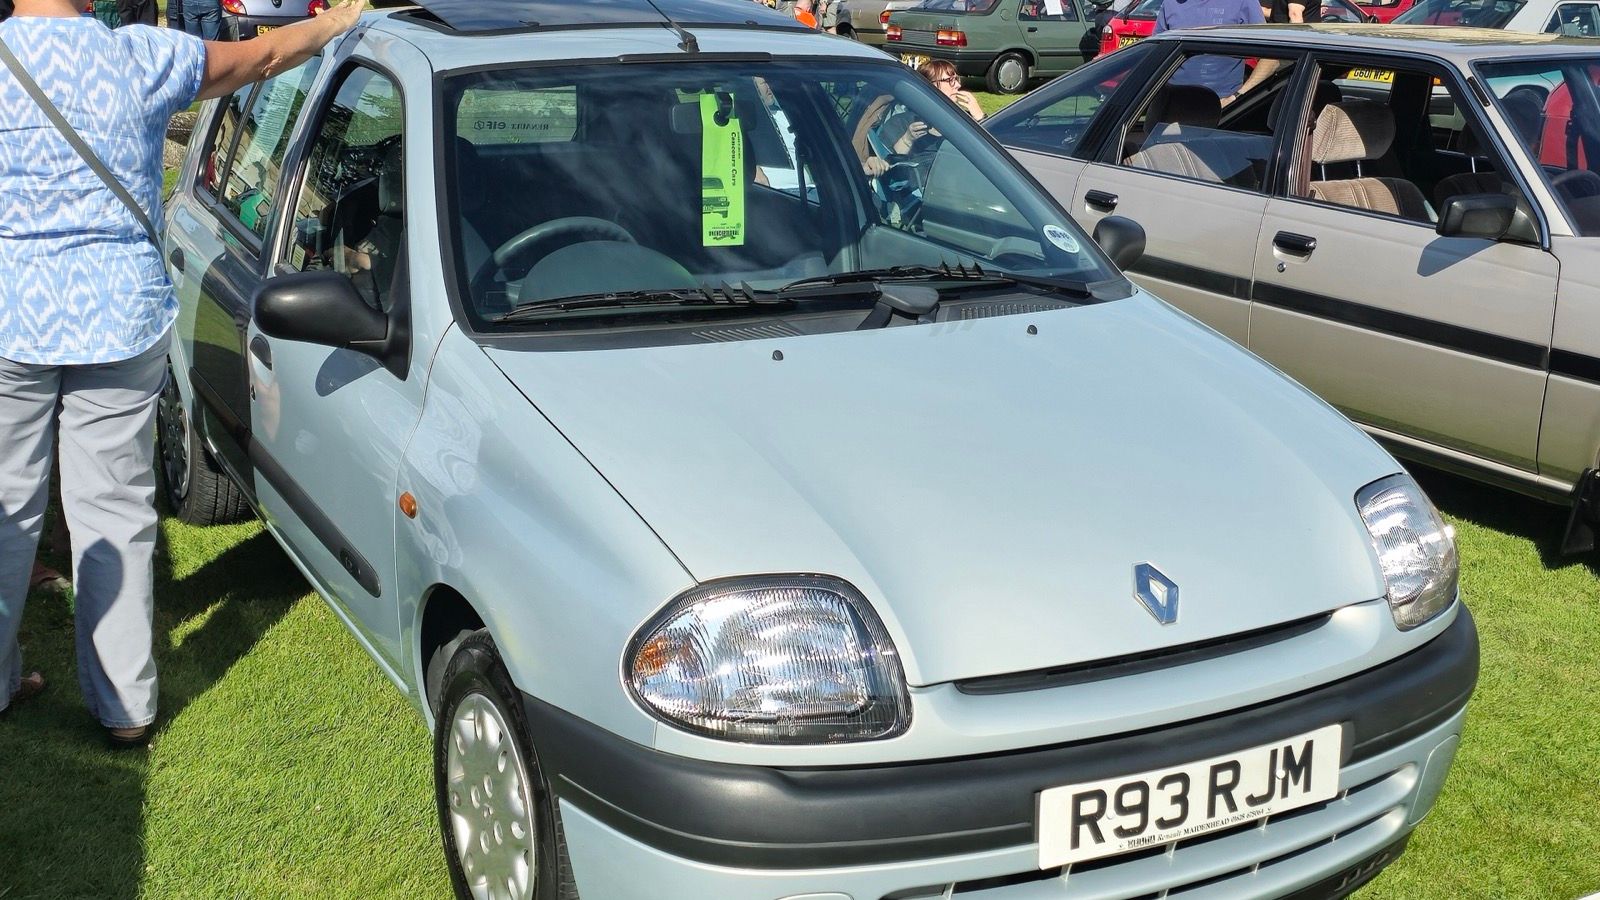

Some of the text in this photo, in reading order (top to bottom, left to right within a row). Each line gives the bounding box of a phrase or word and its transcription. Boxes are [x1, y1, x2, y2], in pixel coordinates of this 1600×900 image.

[1071, 740, 1313, 849] R93 RJM
[1184, 818, 1229, 835] MAIDENHEAD
